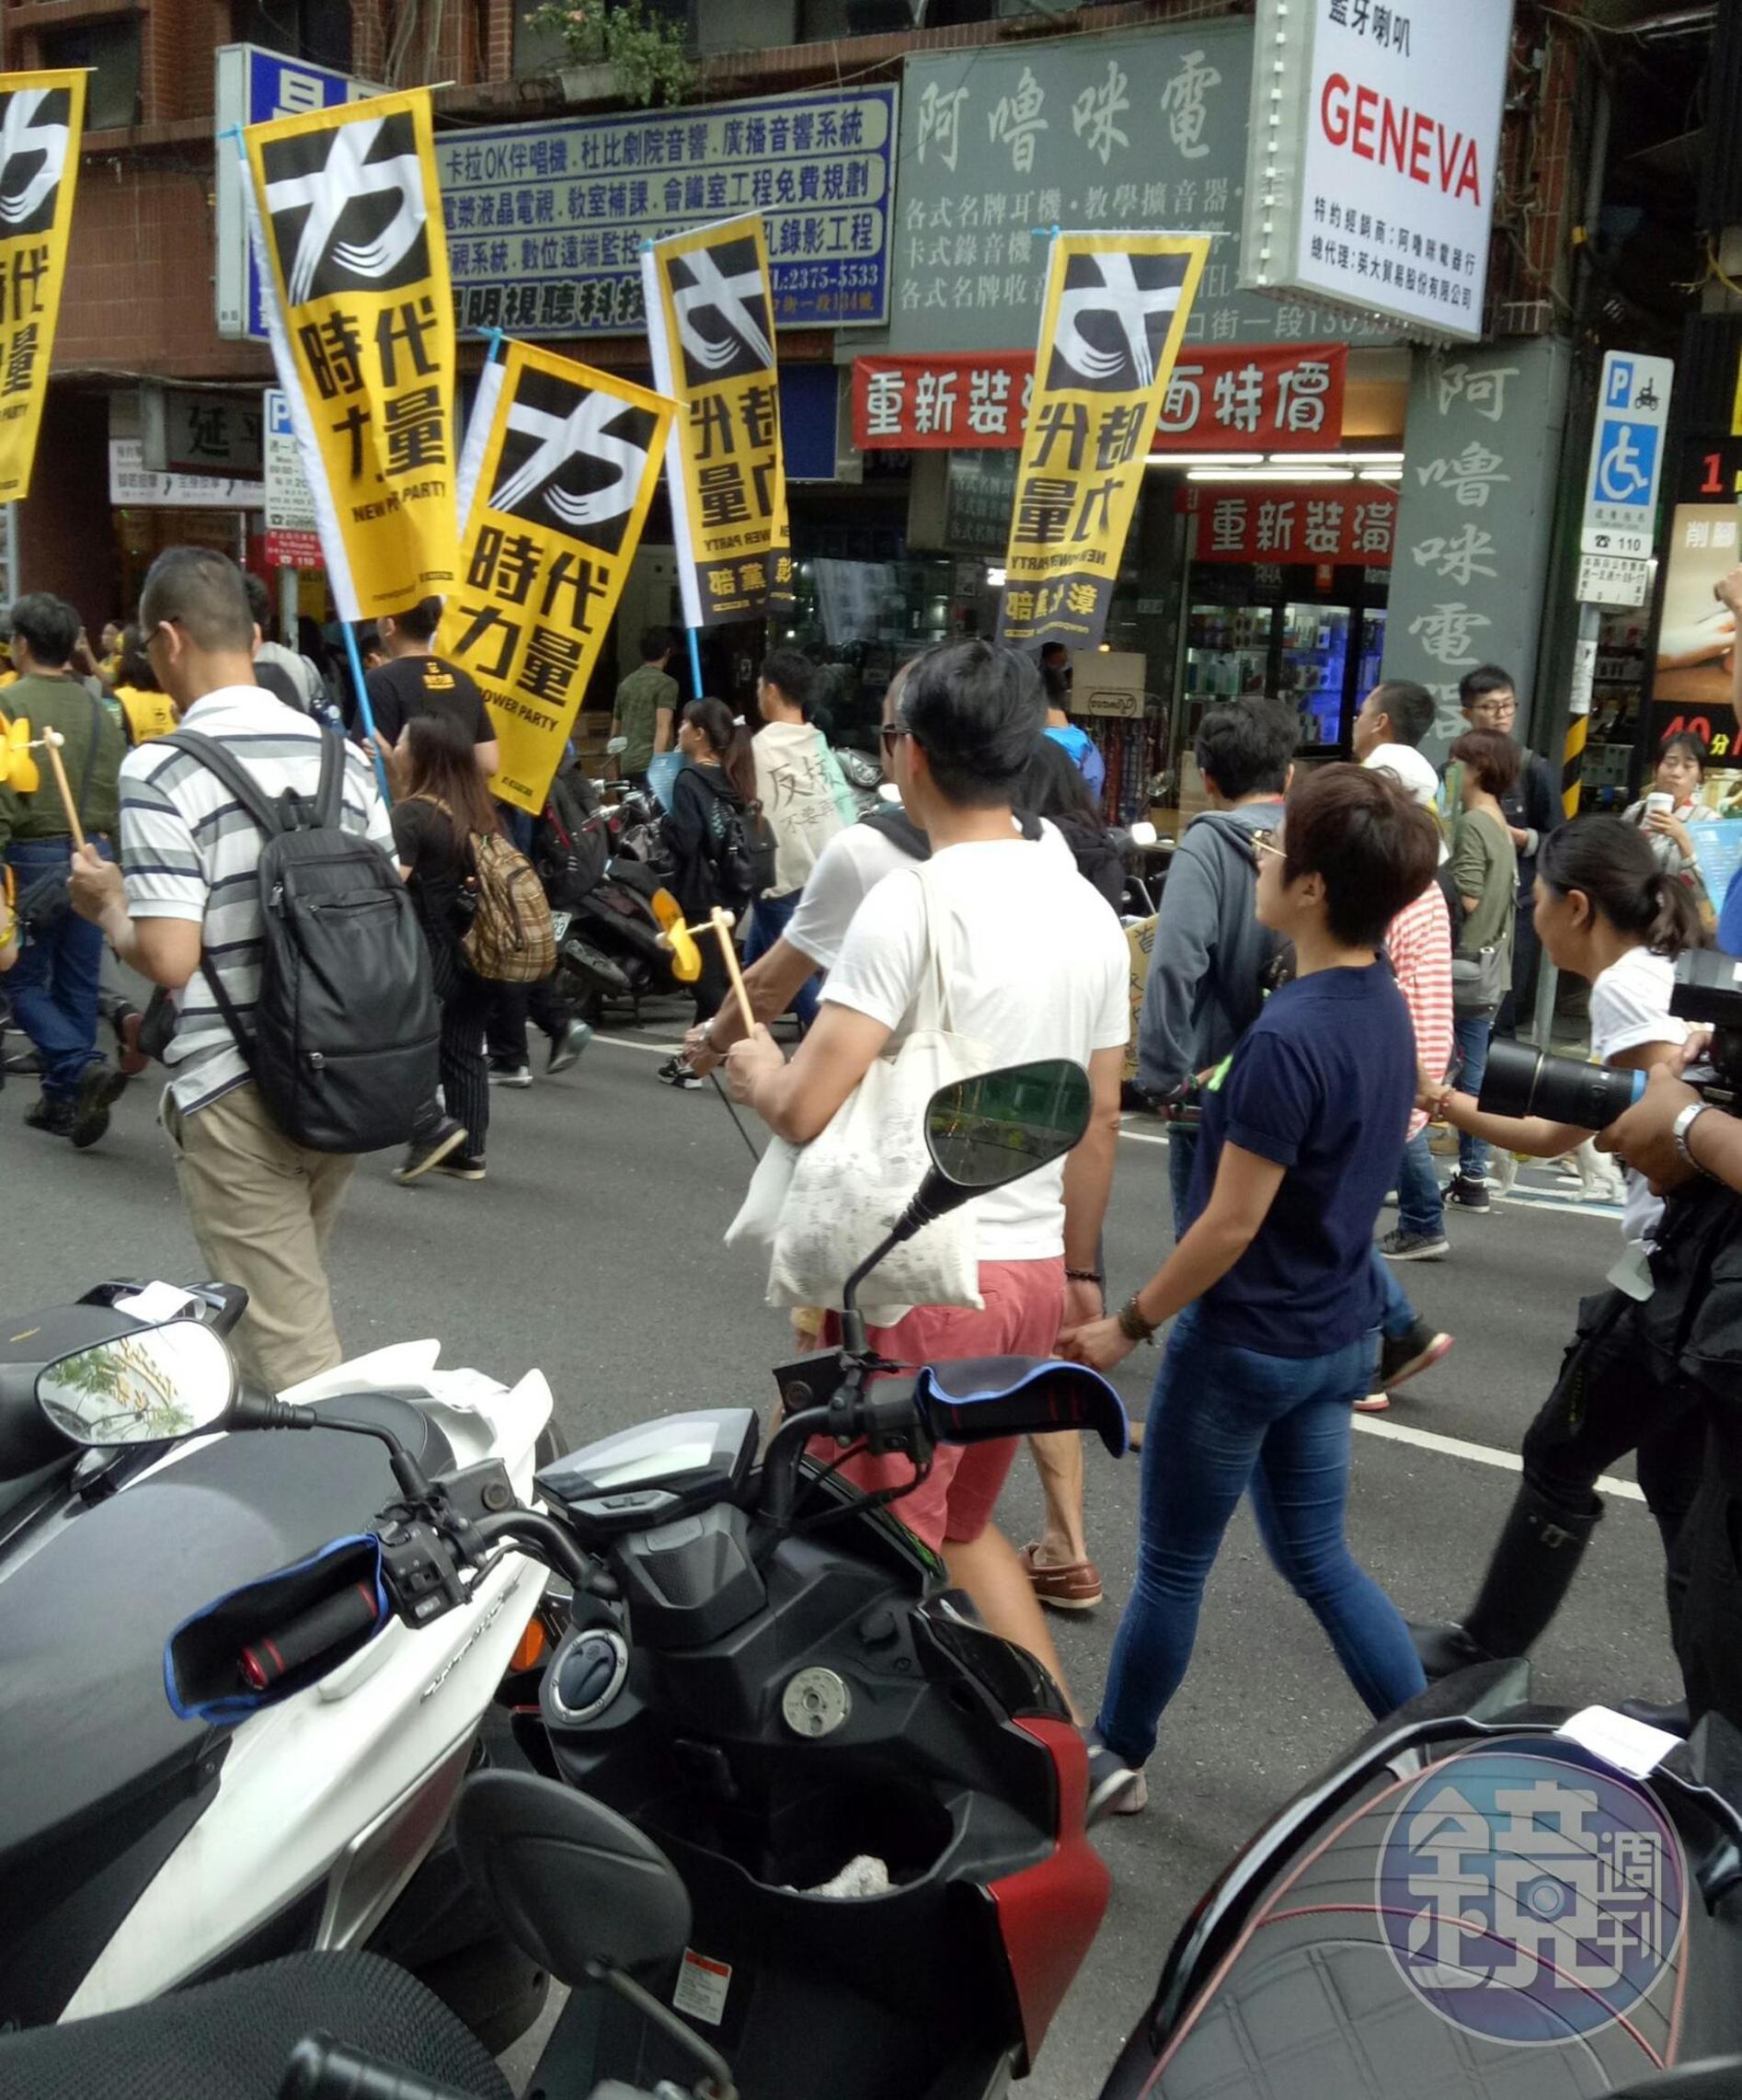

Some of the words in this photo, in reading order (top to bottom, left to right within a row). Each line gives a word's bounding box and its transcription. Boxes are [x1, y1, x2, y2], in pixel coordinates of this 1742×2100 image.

[1321, 73, 1481, 207] GENEVA
[452, 278, 645, 327] 明視聽科技
[770, 263, 879, 292] L:2375-5533
[298, 296, 440, 399] 時代
[1211, 499, 1394, 554] 重新裝潢
[1619, 537, 1641, 552] 110
[466, 524, 610, 635] 時代
[451, 604, 584, 707] 力量
[518, 705, 559, 732] PARTY
